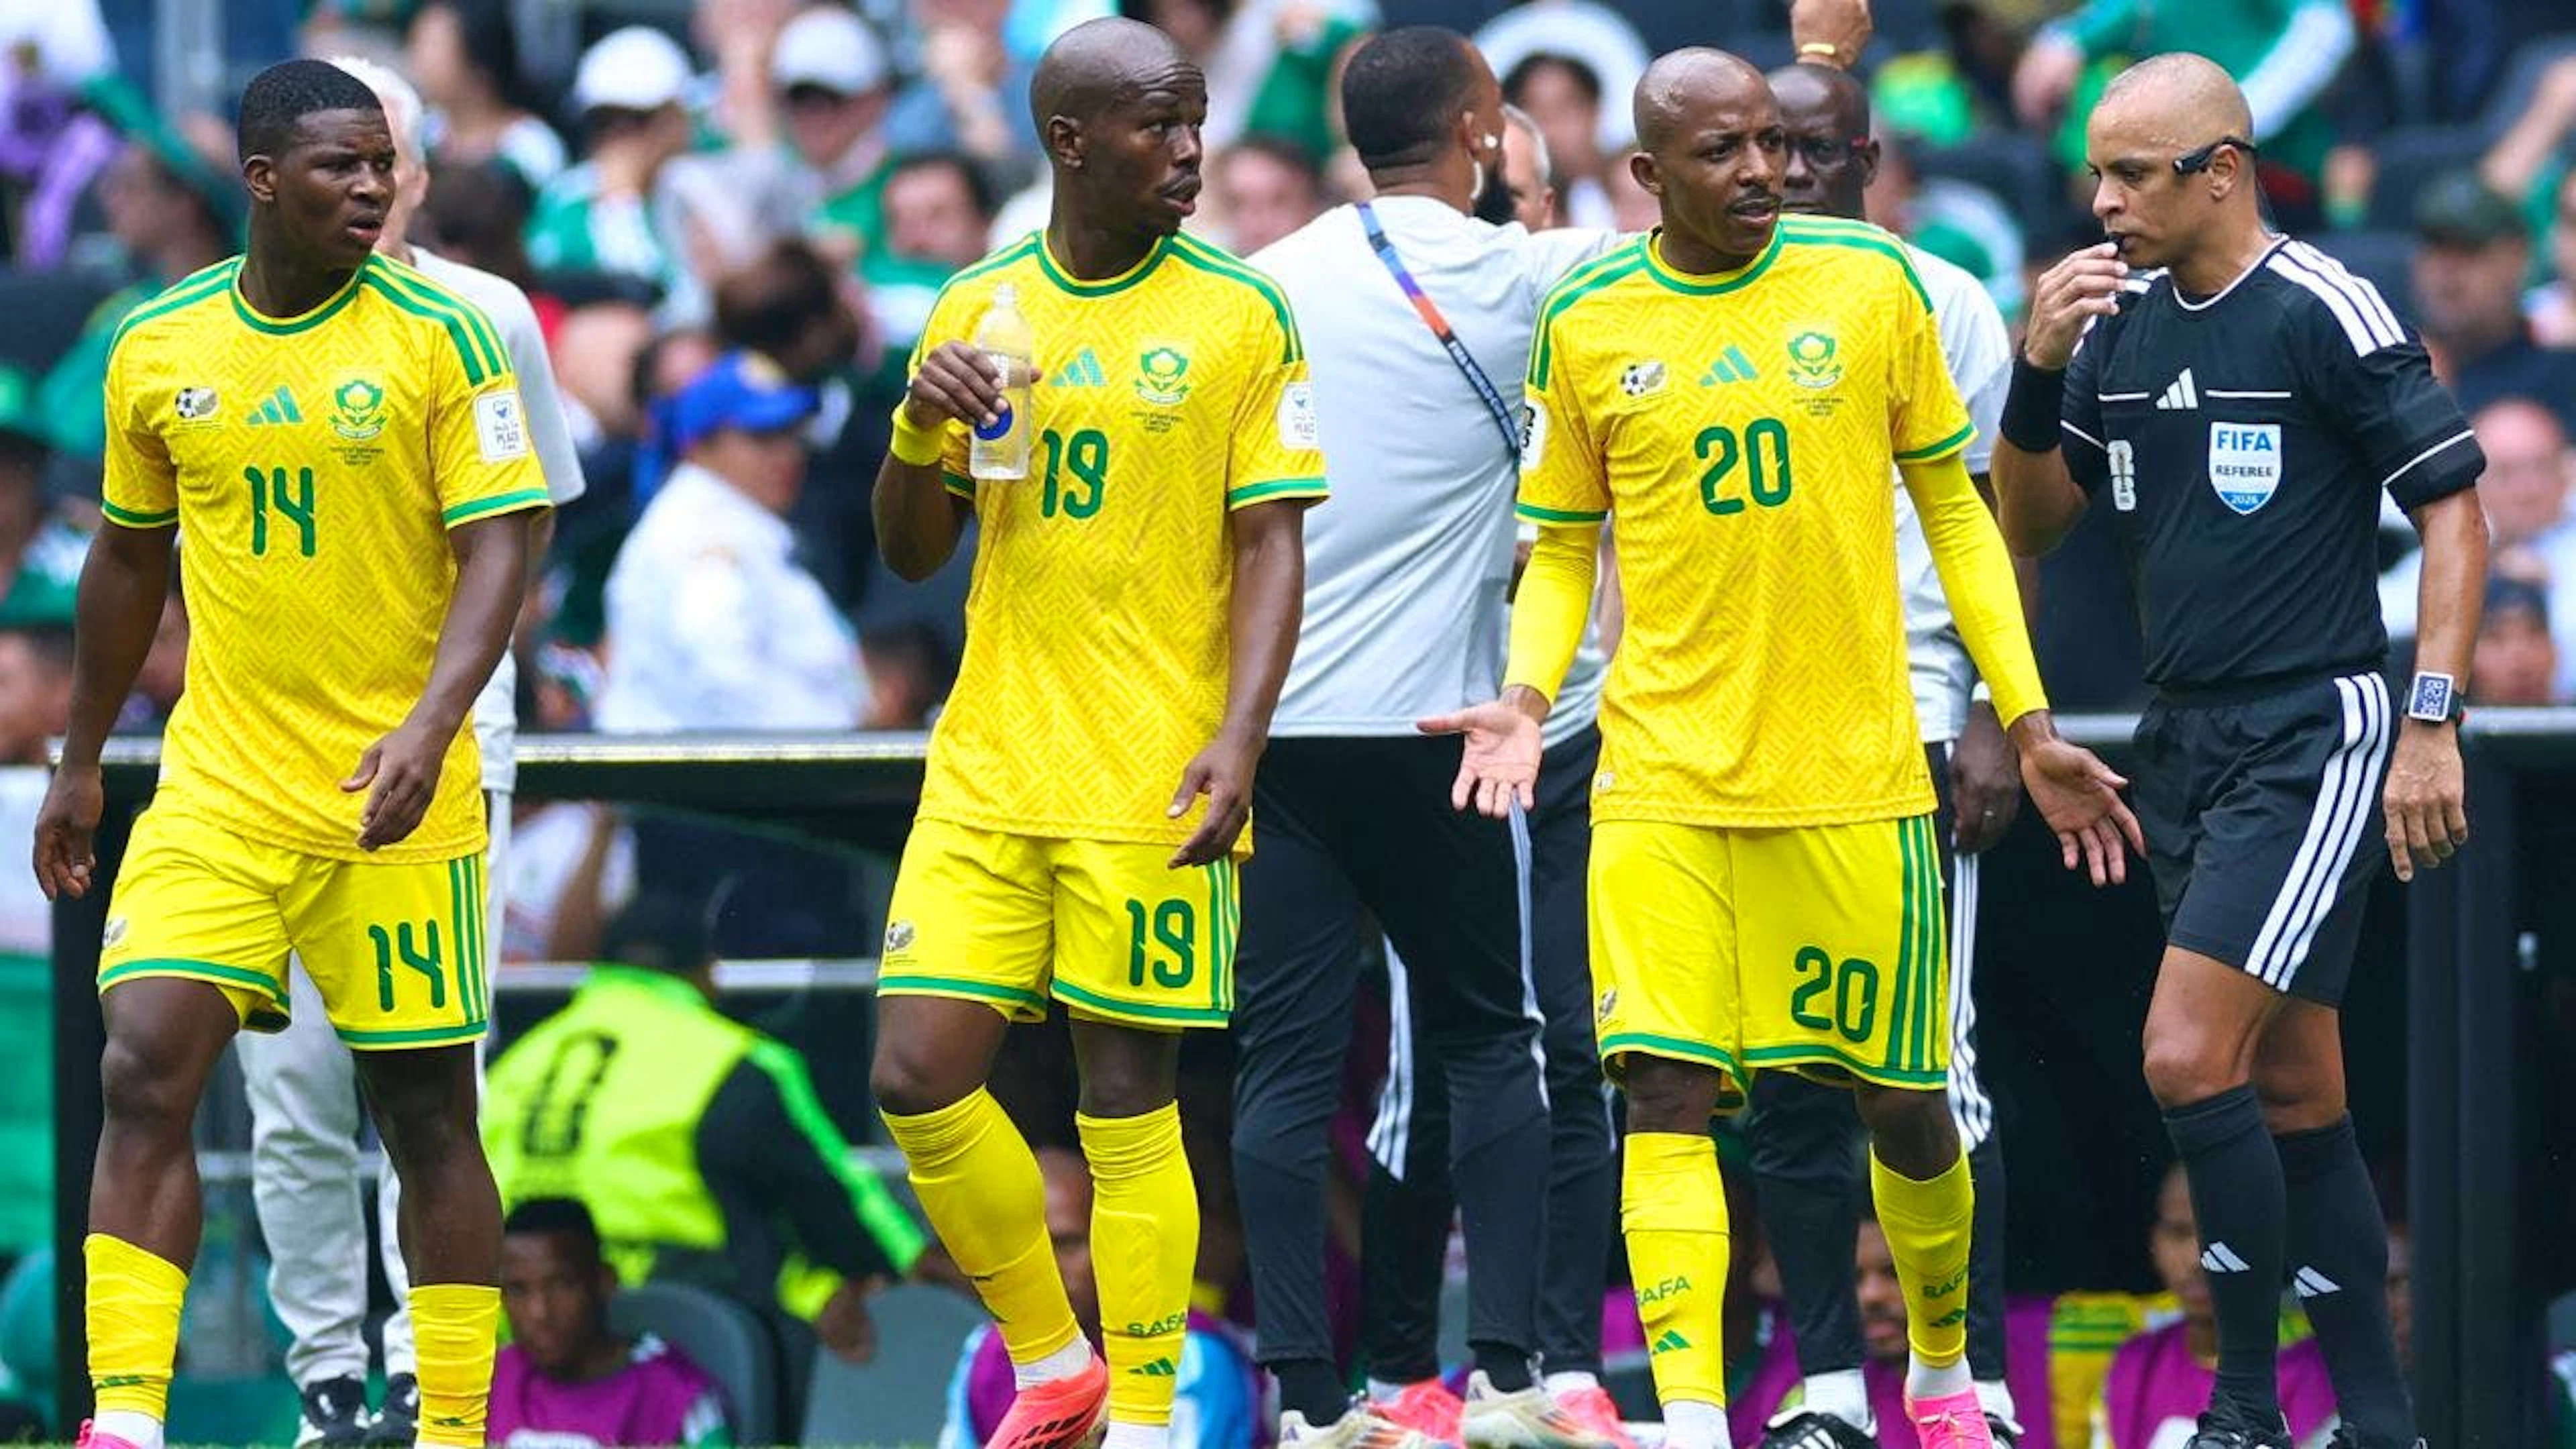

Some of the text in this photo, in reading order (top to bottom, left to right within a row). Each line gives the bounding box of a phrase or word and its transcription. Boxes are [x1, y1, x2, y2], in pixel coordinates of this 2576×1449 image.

[1042, 429, 1108, 519] 19
[1695, 418, 1791, 515] 20
[2215, 464, 2273, 478] REFEREE
[2217, 429, 2273, 451] FIFA
[244, 466, 315, 557] 14
[368, 920, 445, 1012] 14
[1126, 898, 1194, 988] 19
[1791, 946, 1878, 1043] 20
